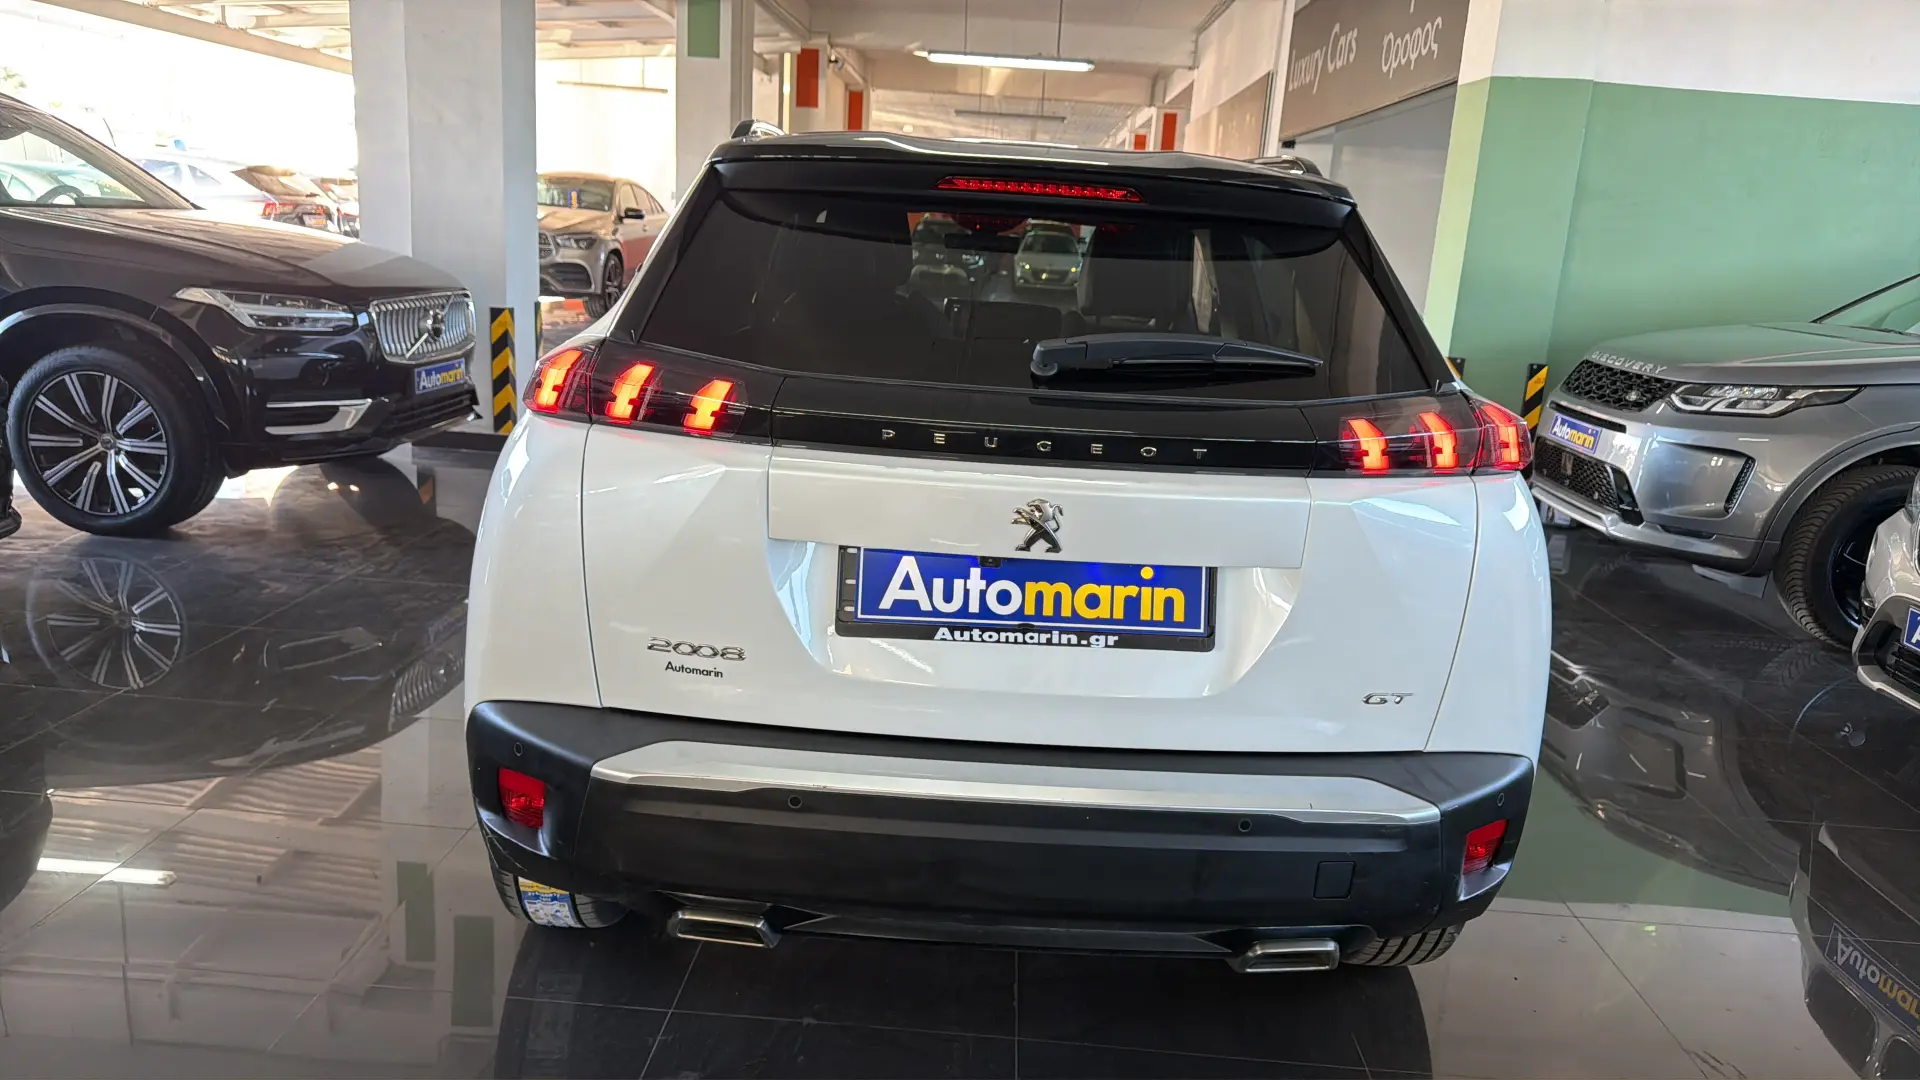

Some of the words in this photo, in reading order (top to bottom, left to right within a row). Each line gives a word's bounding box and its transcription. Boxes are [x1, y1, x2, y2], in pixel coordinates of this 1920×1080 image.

[1288, 46, 1326, 94] Luxury
[1328, 22, 1357, 74] Cars
[1592, 351, 1667, 374] DISCOVERY
[882, 429, 1208, 460] PEUGEOT
[1552, 418, 1595, 449] Automarin
[878, 555, 1185, 622] Automarin
[647, 637, 746, 661] 2008
[933, 627, 1119, 648] Automarin.gr
[665, 661, 723, 678] Automarin
[1362, 692, 1413, 704] GT
